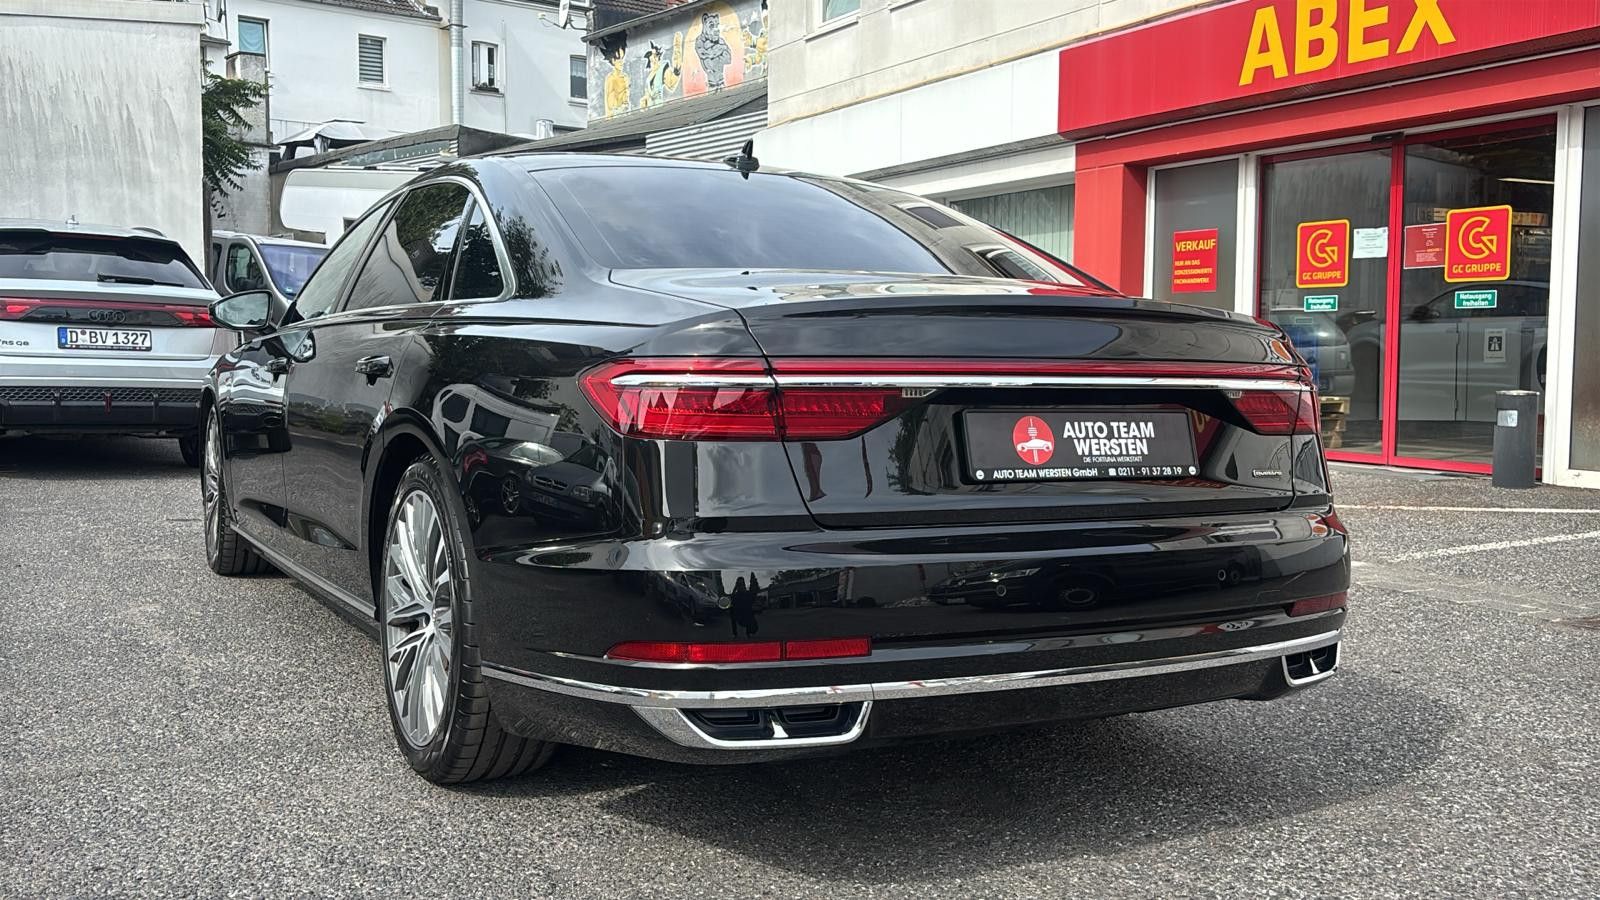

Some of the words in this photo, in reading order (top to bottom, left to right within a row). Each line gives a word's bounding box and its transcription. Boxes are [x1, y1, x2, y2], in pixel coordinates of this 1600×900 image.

[1238, 0, 1457, 86] ABEX
[1175, 239, 1217, 252] VERKAUF
[1452, 264, 1463, 273] GC
[1465, 263, 1502, 273] GRUPPE
[1302, 272, 1312, 280] GC
[1312, 271, 1342, 280] GRUPPE
[68, 330, 79, 344] D
[88, 331, 109, 344] BV
[112, 332, 148, 346] 1327
[1063, 421, 1108, 438] AUTO
[1110, 421, 1155, 438] TEAM
[1073, 438, 1149, 456] WERSTEN
[993, 469, 1014, 479] AUTO
[1015, 469, 1037, 479] TEAM
[1038, 468, 1072, 478] WERSTEN
[1072, 468, 1098, 477] GmbH
[1118, 467, 1135, 476] 0211
[1141, 467, 1150, 476] 91
[1152, 467, 1160, 476] 37
[1162, 467, 1171, 476] 28
[1173, 466, 1182, 475] 19
